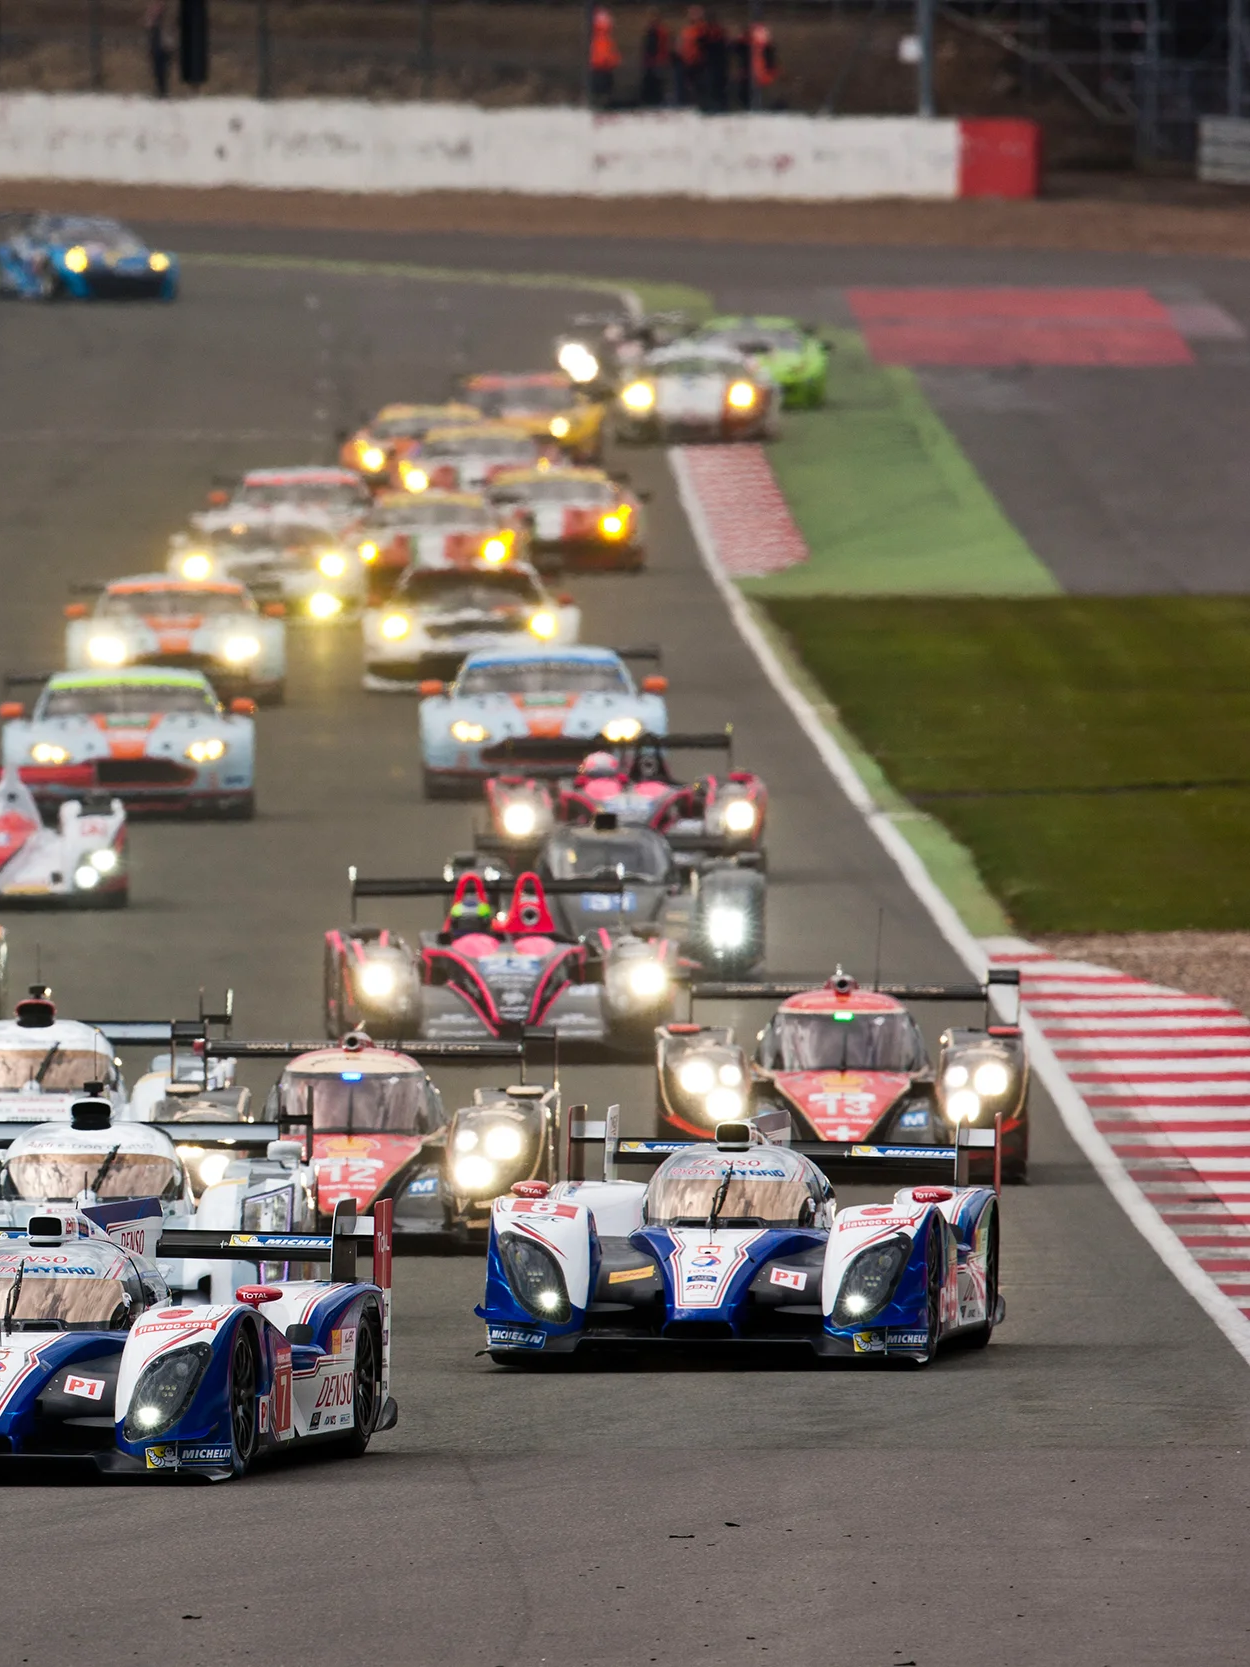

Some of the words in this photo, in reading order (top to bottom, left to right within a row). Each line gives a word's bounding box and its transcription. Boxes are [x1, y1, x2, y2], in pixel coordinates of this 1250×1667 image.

[824, 1096, 870, 1115] 13
[693, 1159, 761, 1167] DENSO
[321, 1165, 376, 1183] 12
[520, 1186, 542, 1195] TOTAL
[914, 1191, 939, 1199] TOTAL
[530, 1202, 558, 1214] 8
[841, 1218, 911, 1230] fiawec.com
[120, 1229, 145, 1255] DENSO
[22, 1265, 96, 1275] HYBRID
[774, 1272, 801, 1286] P1
[240, 1291, 269, 1299] TOTAL
[138, 1320, 213, 1334] fiawec.com
[491, 1329, 543, 1344] MICHELIN
[68, 1378, 98, 1396] P1
[315, 1371, 353, 1408] DENSO
[280, 1374, 288, 1428] 7
